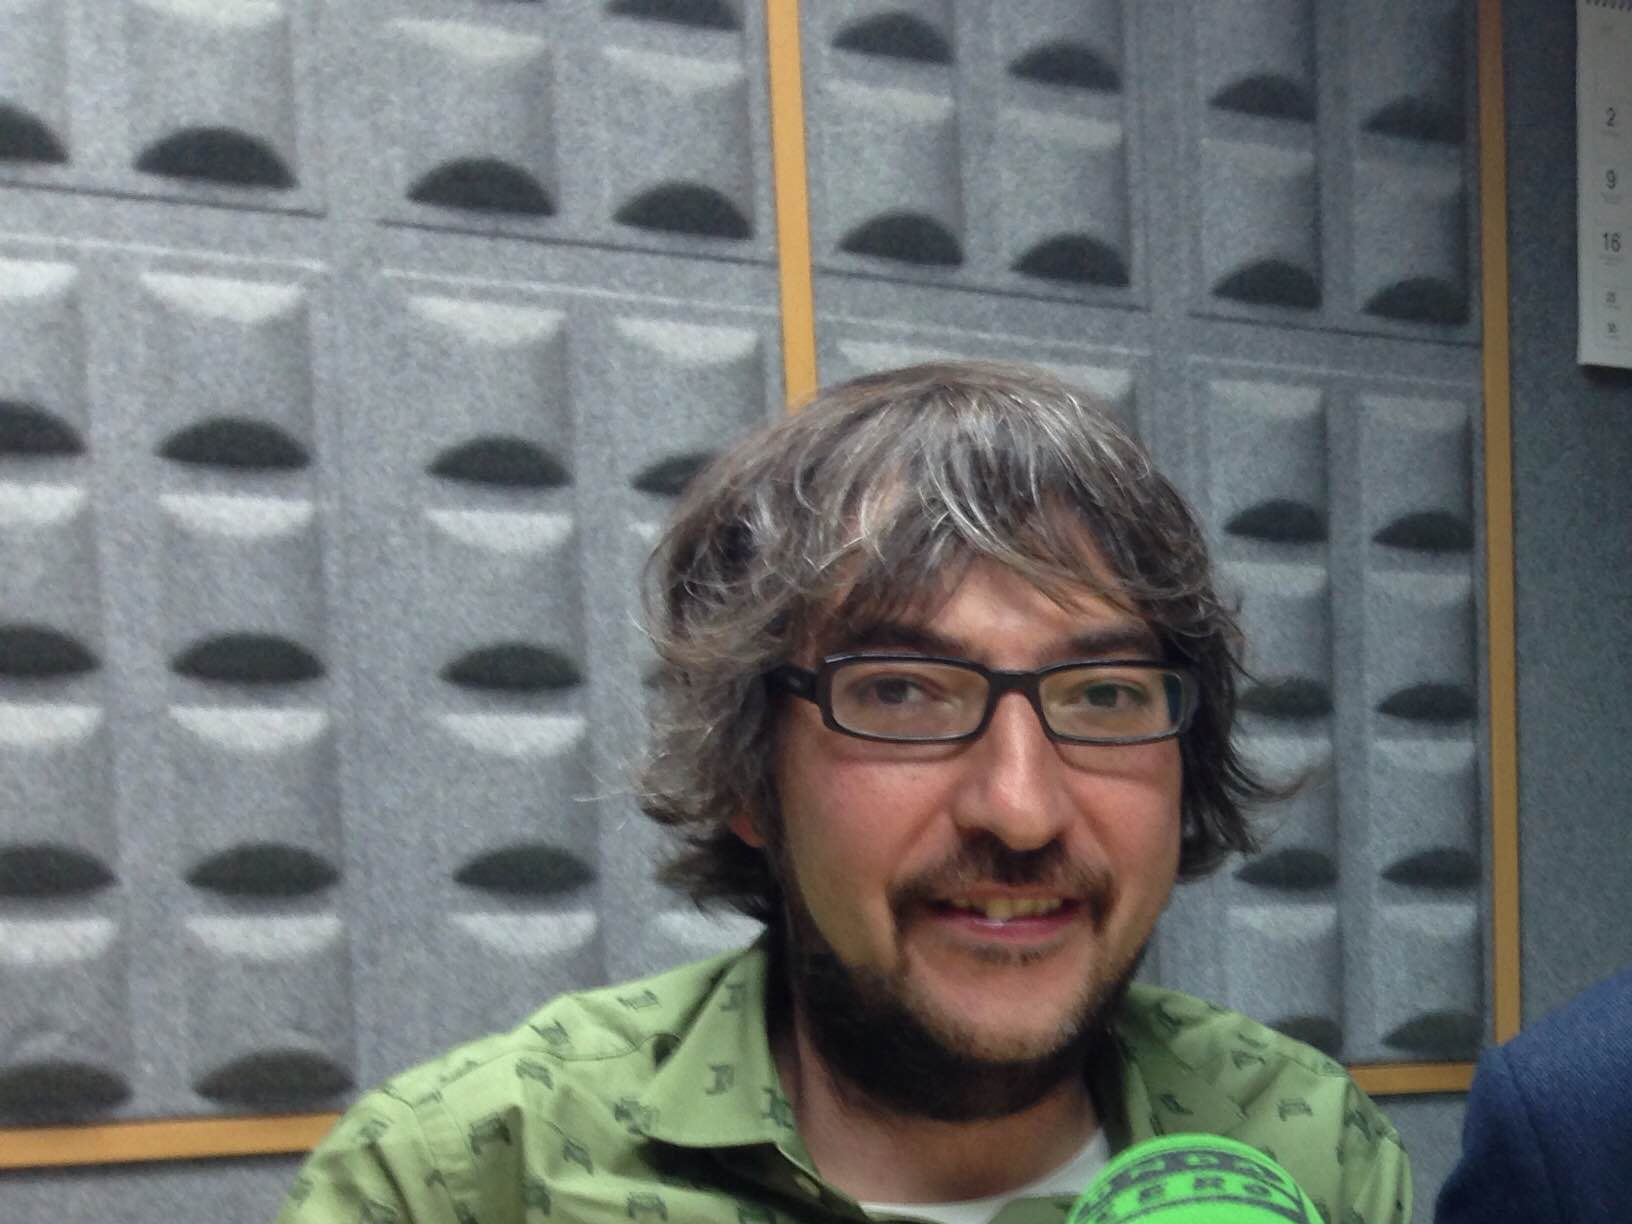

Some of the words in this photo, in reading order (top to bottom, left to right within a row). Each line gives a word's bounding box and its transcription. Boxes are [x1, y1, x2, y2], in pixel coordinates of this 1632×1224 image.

[1605, 106, 1617, 128] 2
[1605, 168, 1617, 190] 9
[1602, 231, 1622, 253] 16
